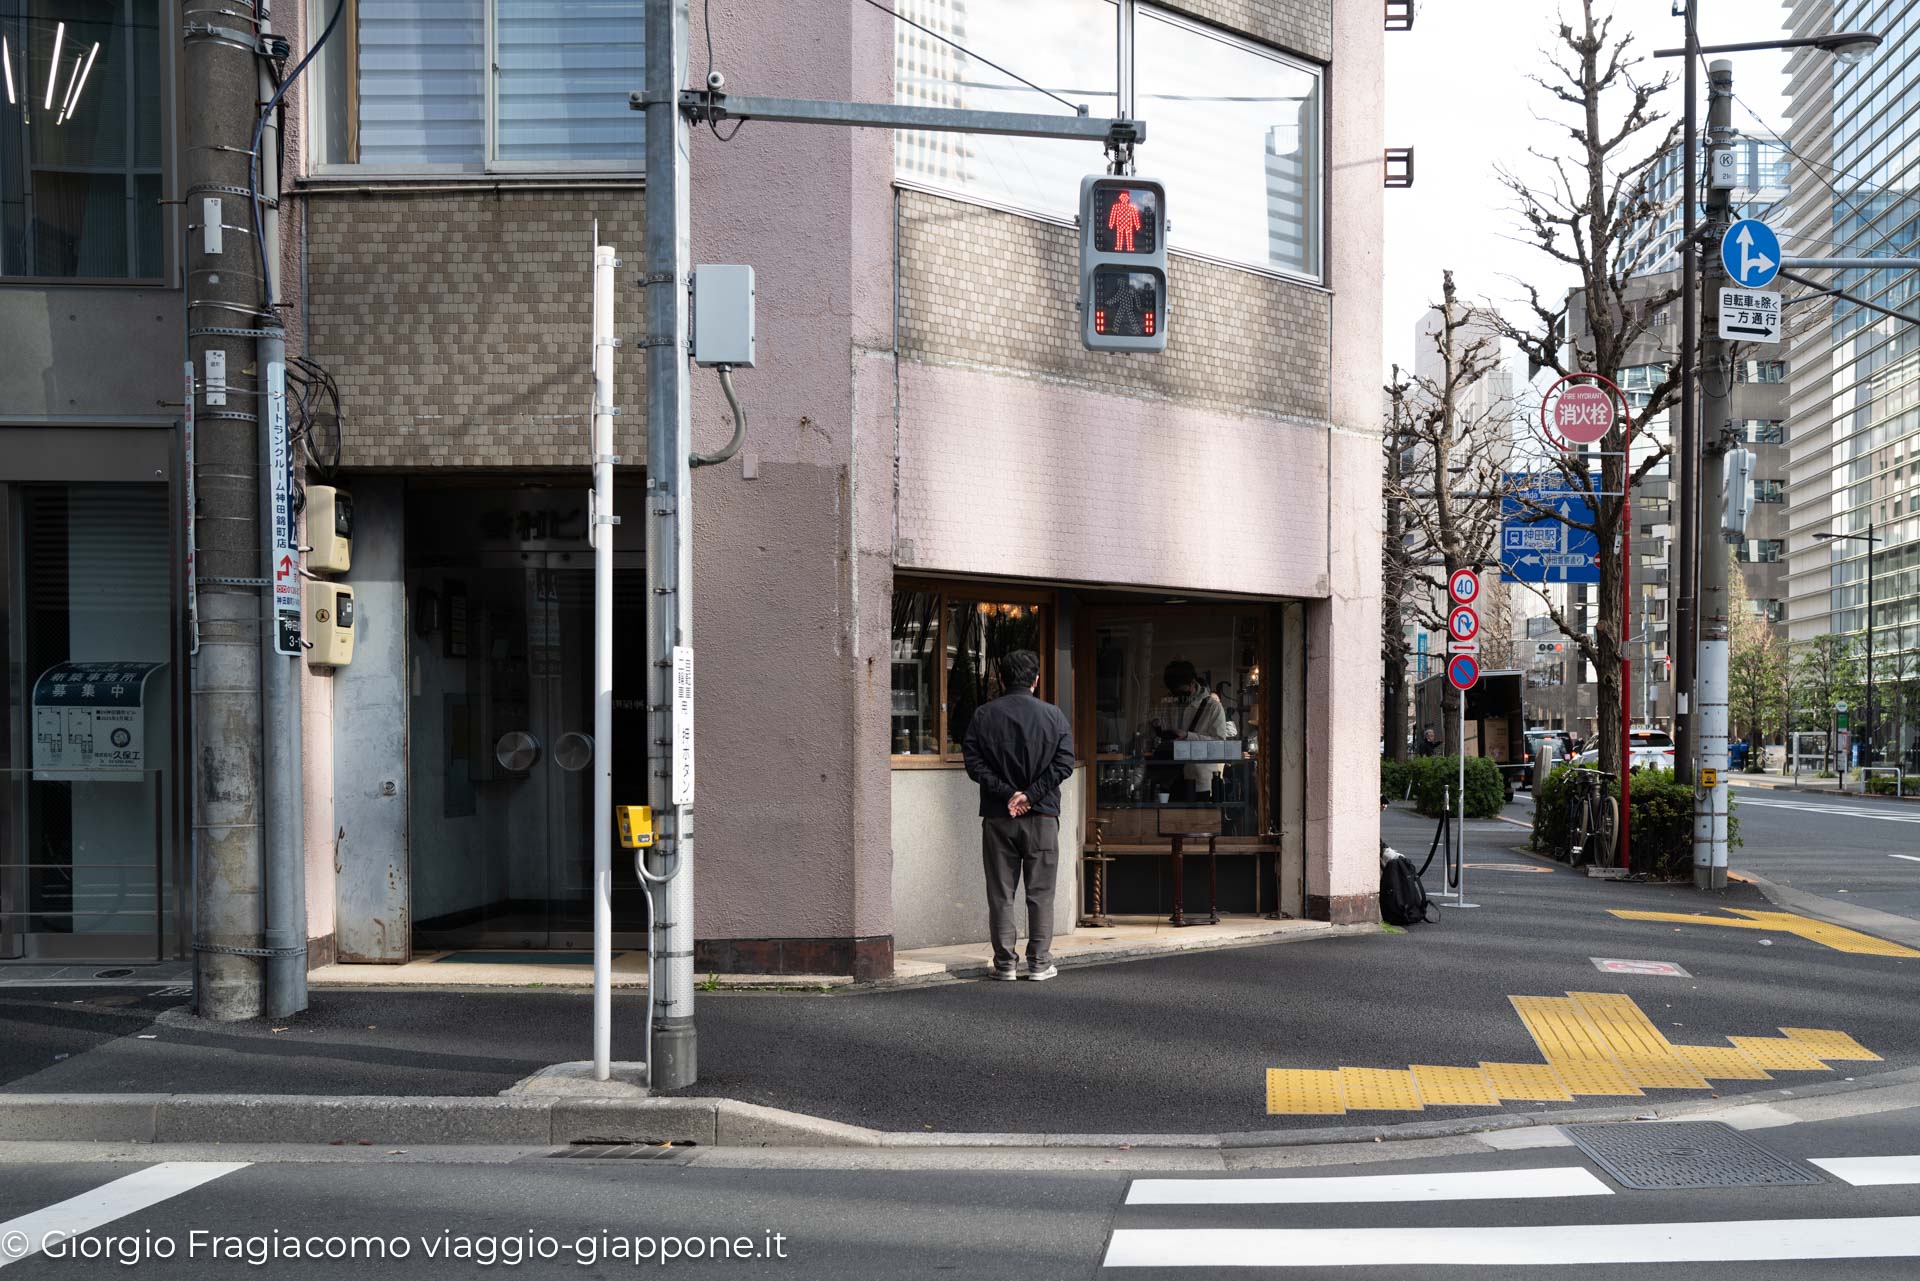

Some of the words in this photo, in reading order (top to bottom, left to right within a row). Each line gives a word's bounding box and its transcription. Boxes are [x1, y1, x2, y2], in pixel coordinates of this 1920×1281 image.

[1723, 293, 1778, 310] 自転車を除く
[1723, 311, 1777, 326] 一方通行
[1577, 392, 1603, 400] HYDRANT
[1559, 402, 1609, 426] 消火栓
[1523, 529, 1556, 541] 神田駅
[1456, 579, 1473, 595] 40
[50, 672, 138, 682] 新築事務所
[52, 683, 124, 699] 募集中
